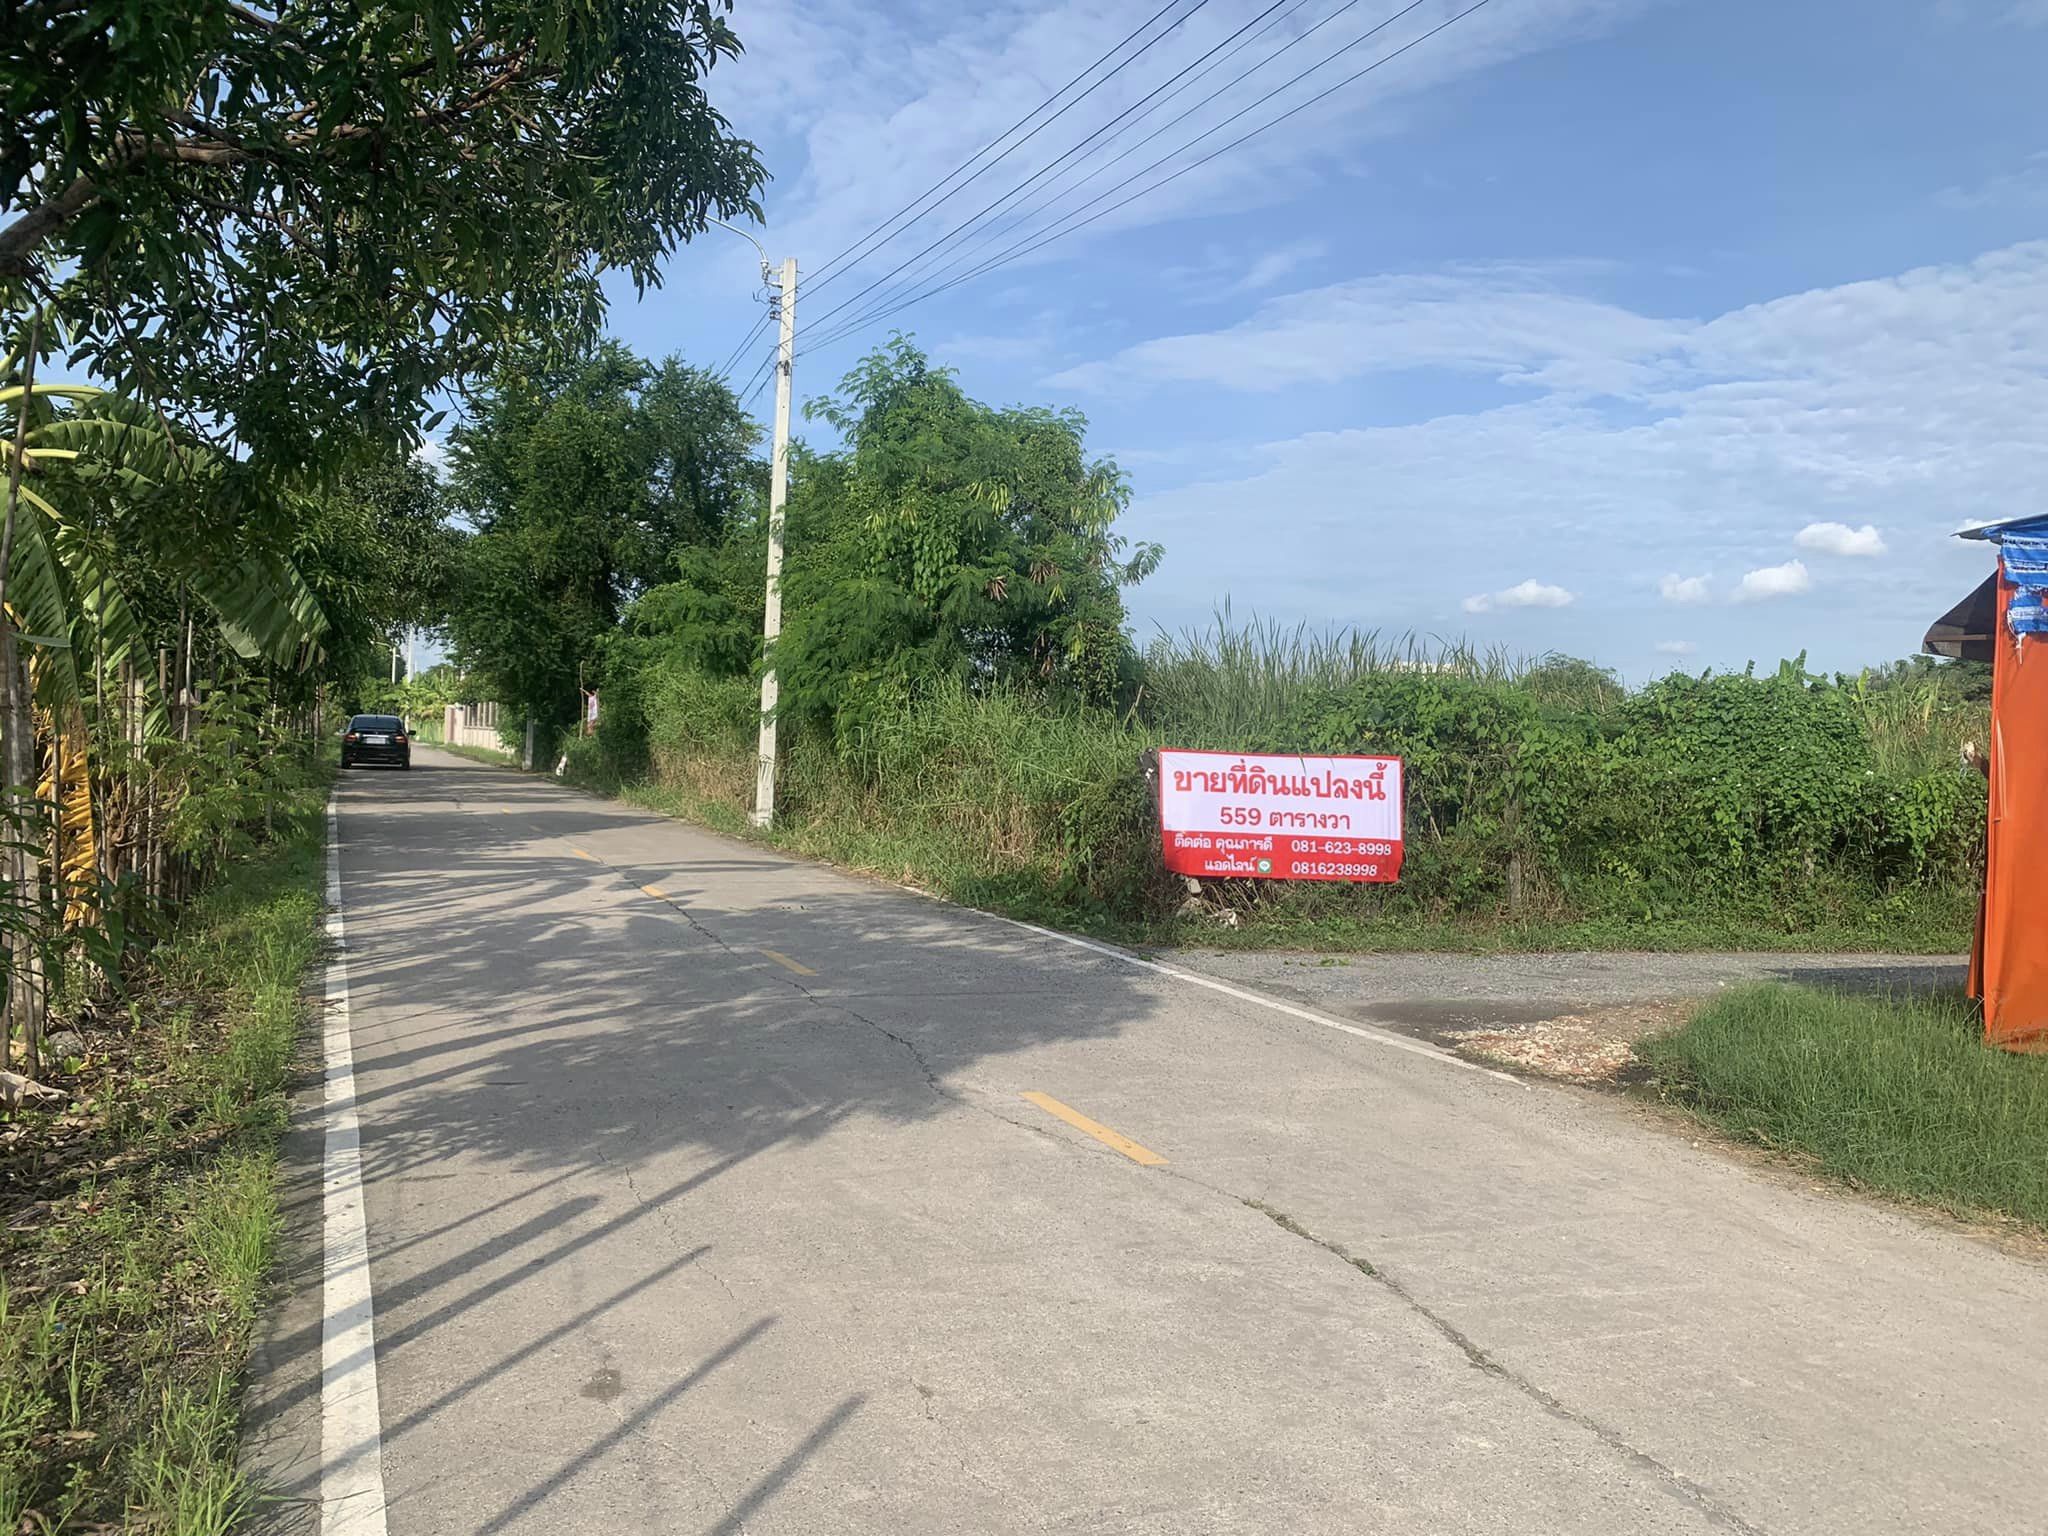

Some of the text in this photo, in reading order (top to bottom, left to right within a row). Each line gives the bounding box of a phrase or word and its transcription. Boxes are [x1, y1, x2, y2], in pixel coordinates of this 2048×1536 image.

[1173, 759, 1387, 801] ขายที่ดินแปลงนี้
[1220, 806, 1351, 830] 559 ตารางวา
[1174, 832, 1212, 849] ติดต่อ
[1291, 839, 1392, 856] 081-623-8998
[1204, 854, 1378, 876] แอดไลน์ 0816238998
